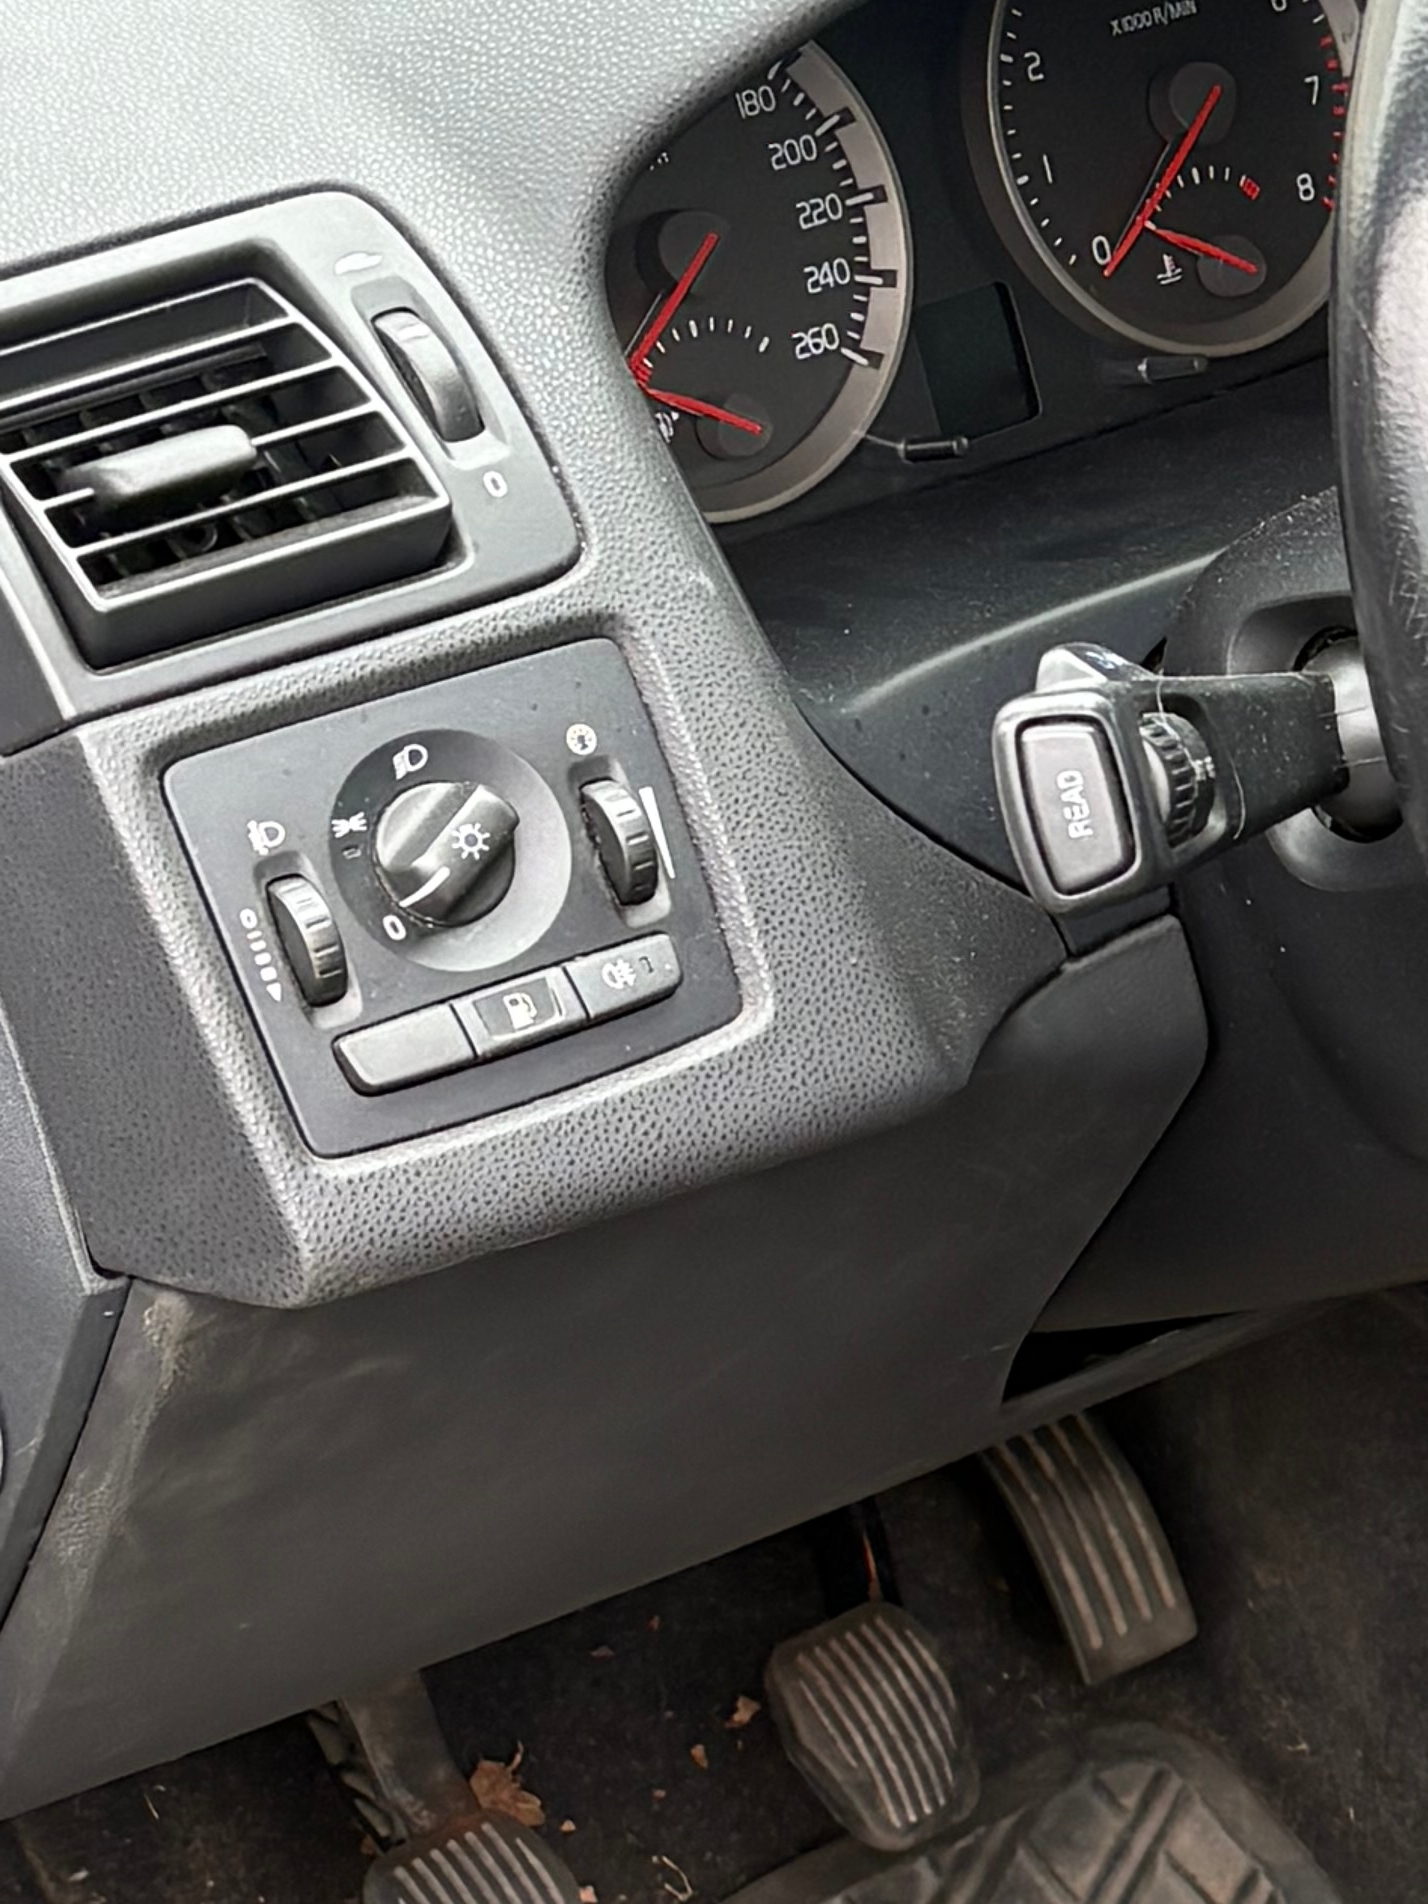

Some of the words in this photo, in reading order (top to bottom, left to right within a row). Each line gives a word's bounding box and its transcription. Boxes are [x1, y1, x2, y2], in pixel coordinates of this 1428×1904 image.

[1023, 50, 1044, 82] 2
[736, 85, 777, 119] 180
[1304, 75, 1320, 105] 7
[768, 133, 818, 171] 200
[1042, 154, 1053, 184] 1
[1296, 173, 1316, 202] 8
[796, 193, 843, 230] 220
[1091, 234, 1113, 265] 0
[803, 258, 851, 294] 240
[792, 323, 841, 360] 260
[1055, 769, 1094, 840] READ
[382, 914, 407, 941] 0
